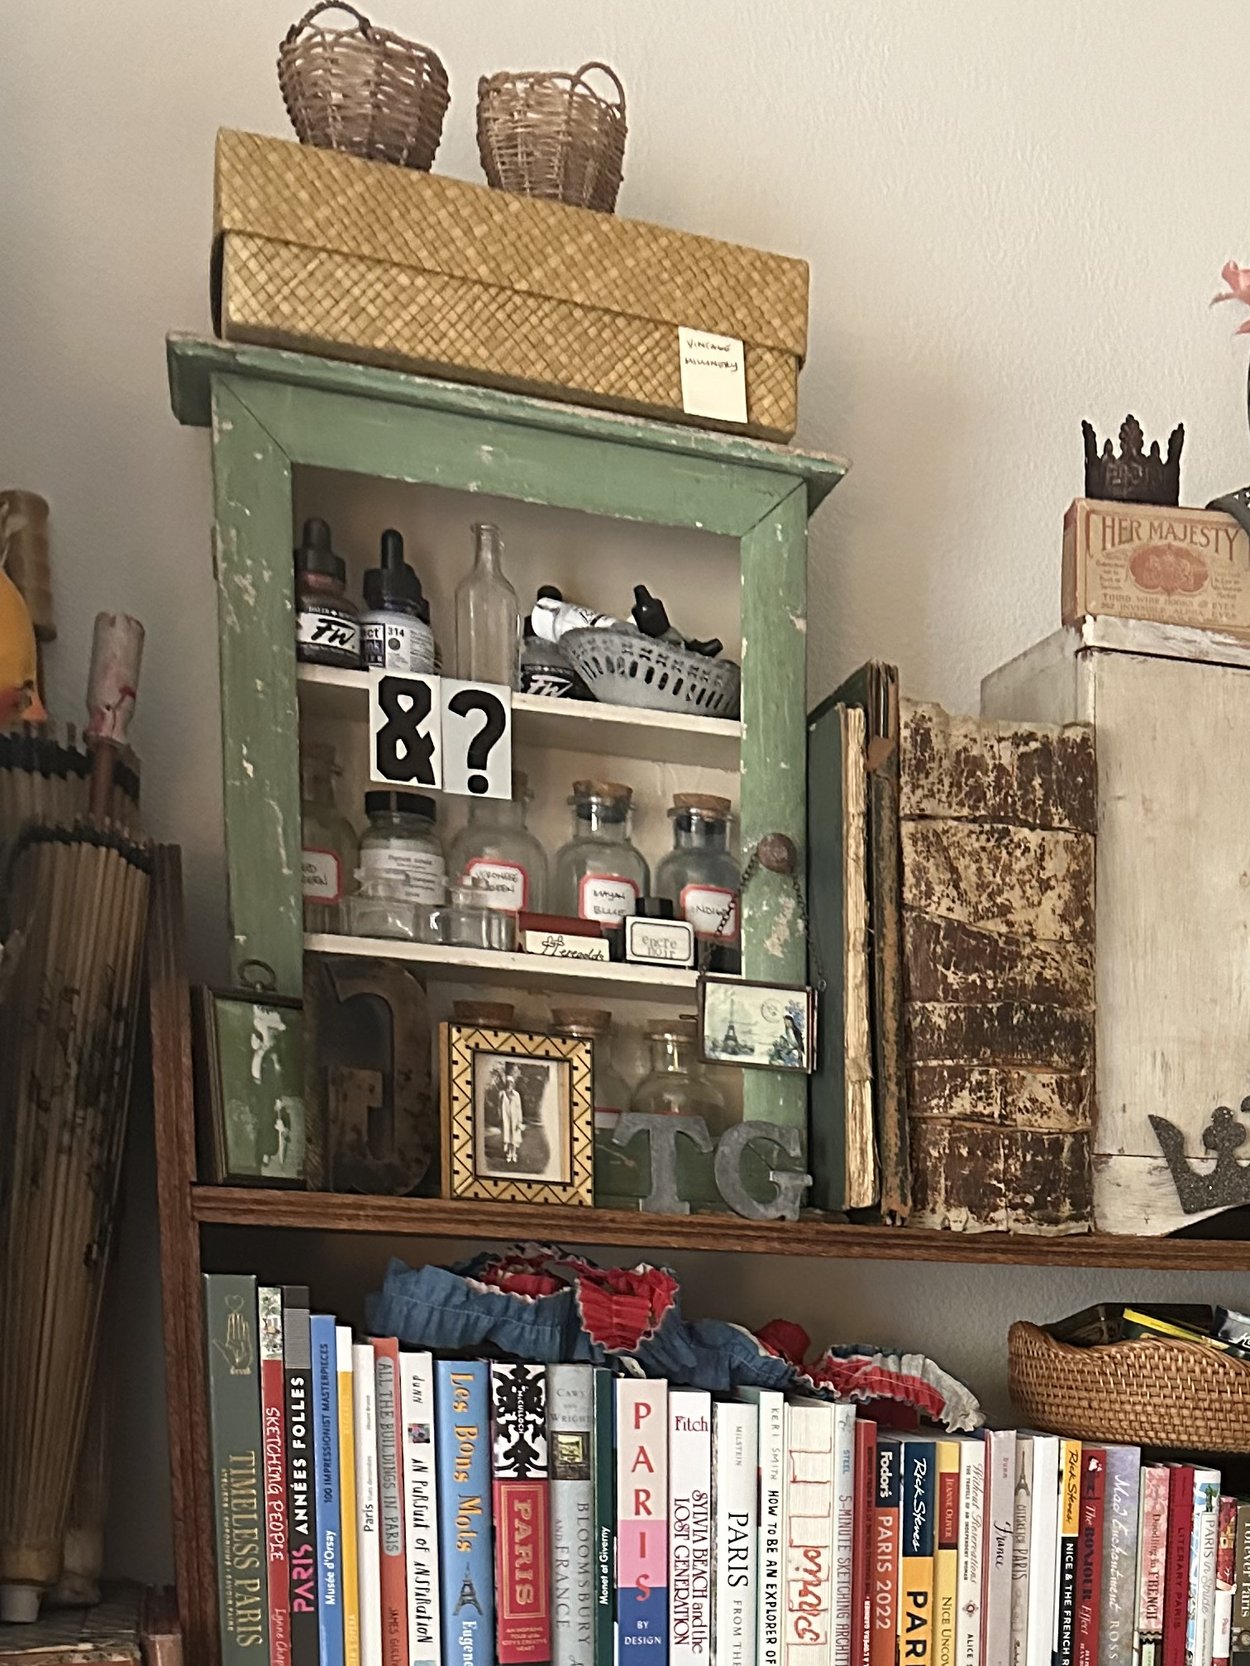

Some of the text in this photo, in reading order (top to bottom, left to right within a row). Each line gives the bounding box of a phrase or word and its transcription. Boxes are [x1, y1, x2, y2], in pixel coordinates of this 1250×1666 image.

[1102, 516, 1239, 561] HER MAJESTY
[387, 627, 404, 638] 314
[642, 936, 677, 949] encre
[675, 1416, 709, 1432] Fitch
[264, 1407, 284, 1560] SKETCHING PEOPLE
[292, 1376, 315, 1613] PARIS ANNÉES FOLLES
[450, 1372, 484, 1552] Les Bons Mots
[1113, 1474, 1130, 1515] Mad
[228, 1450, 255, 1582] TIMELESS
[364, 1503, 374, 1532] Paris
[727, 1512, 749, 1588] PARIS
[324, 1530, 337, 1606] Musée d'Orsay
[513, 1500, 535, 1605] PARIS
[577, 1502, 591, 1645] BLOOMSBURY
[673, 1498, 690, 1646] LOST GENERATION
[876, 1516, 893, 1629] PARIS 2022
[1109, 1519, 1129, 1613] Enchantment
[238, 1585, 262, 1646] PARIS
[554, 1547, 570, 1630] FRANCE
[732, 1600, 743, 1637] FROM
[940, 1597, 952, 1624] NICE
[625, 1636, 662, 1645] DESIGN
[637, 1621, 649, 1630] BY
[1107, 1620, 1120, 1660] ROSS
